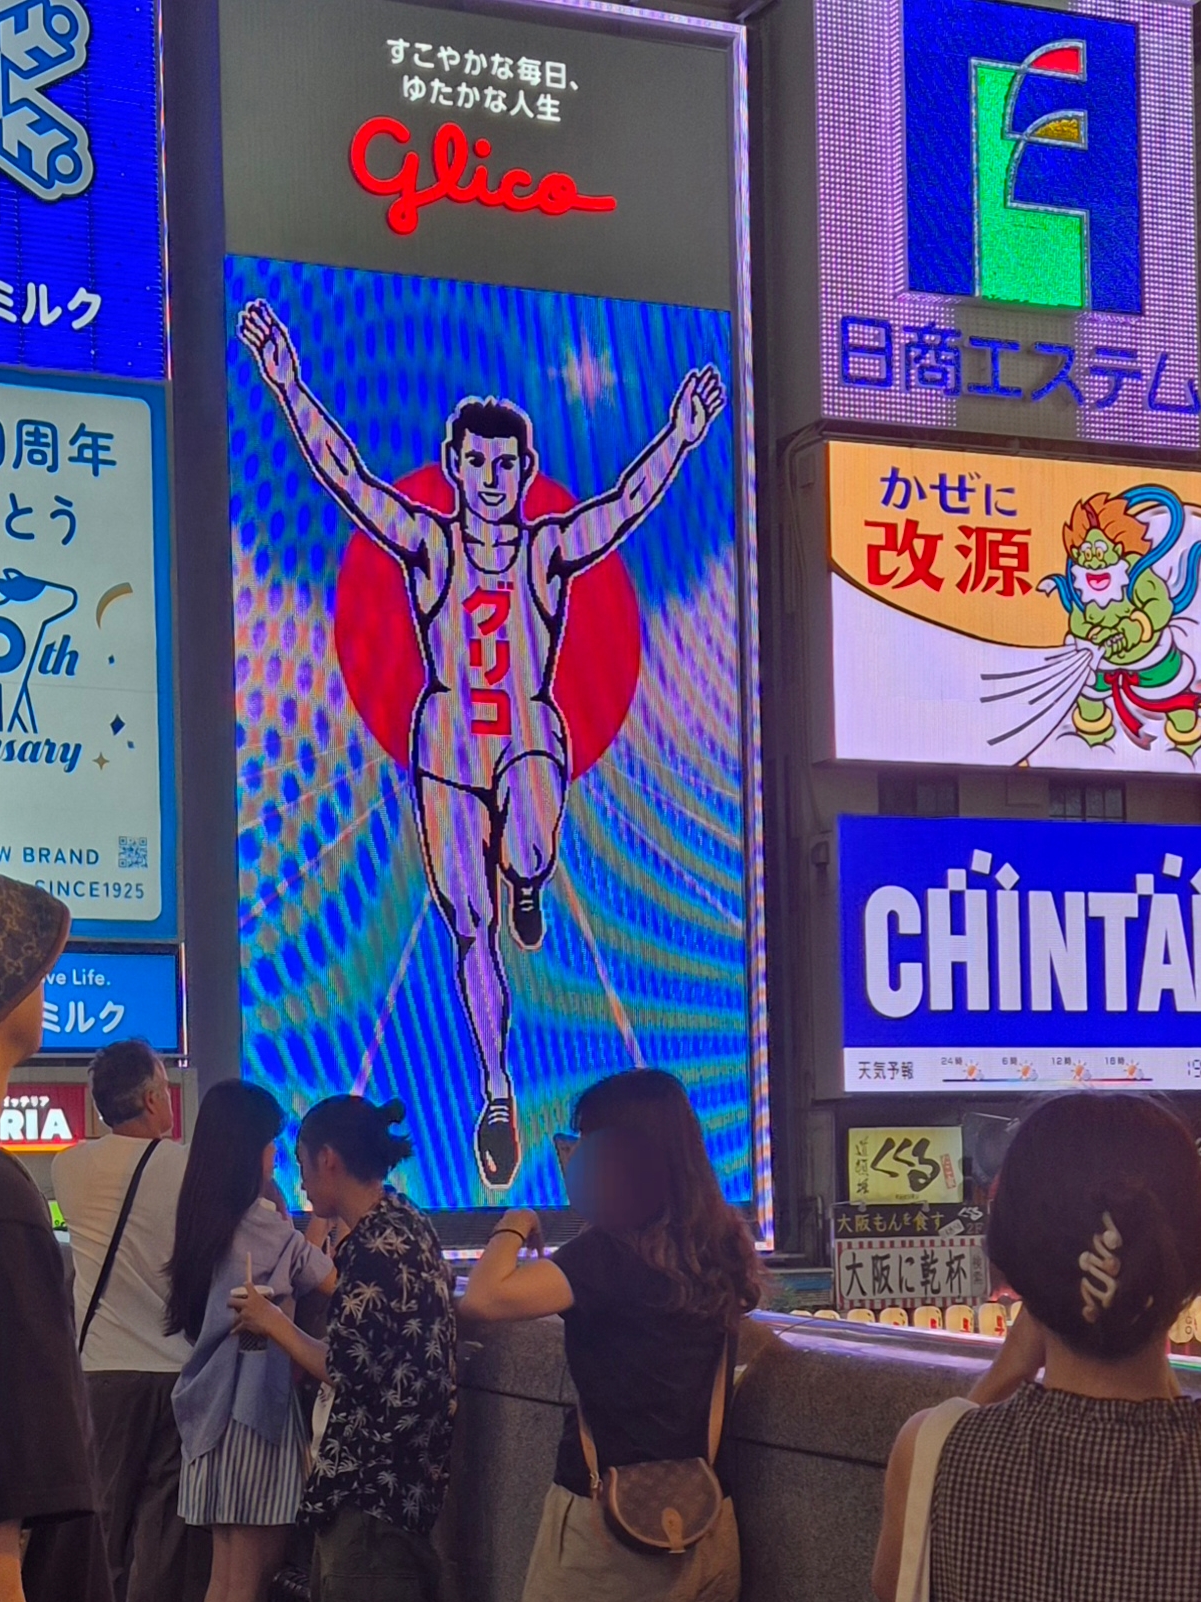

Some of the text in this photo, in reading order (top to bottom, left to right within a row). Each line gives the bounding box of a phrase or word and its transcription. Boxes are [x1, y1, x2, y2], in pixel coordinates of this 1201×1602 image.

[386, 38, 580, 91] すこやかな毎日、
[402, 76, 561, 122] ゆたかな人生
[350, 116, 616, 235] Glico
[840, 315, 1201, 414] 日商エステム
[880, 466, 1018, 517] かぜに
[863, 518, 1032, 597] 改源
[462, 580, 514, 738] グリコ
[22, 846, 100, 866] BRAND
[72, 968, 111, 986] Life.
[858, 1061, 914, 1080] 天気予報
[870, 1138, 941, 1192] くくる
[837, 1211, 945, 1233] 大阪もんを食す
[845, 1248, 967, 1299] 大阪に乾杯
